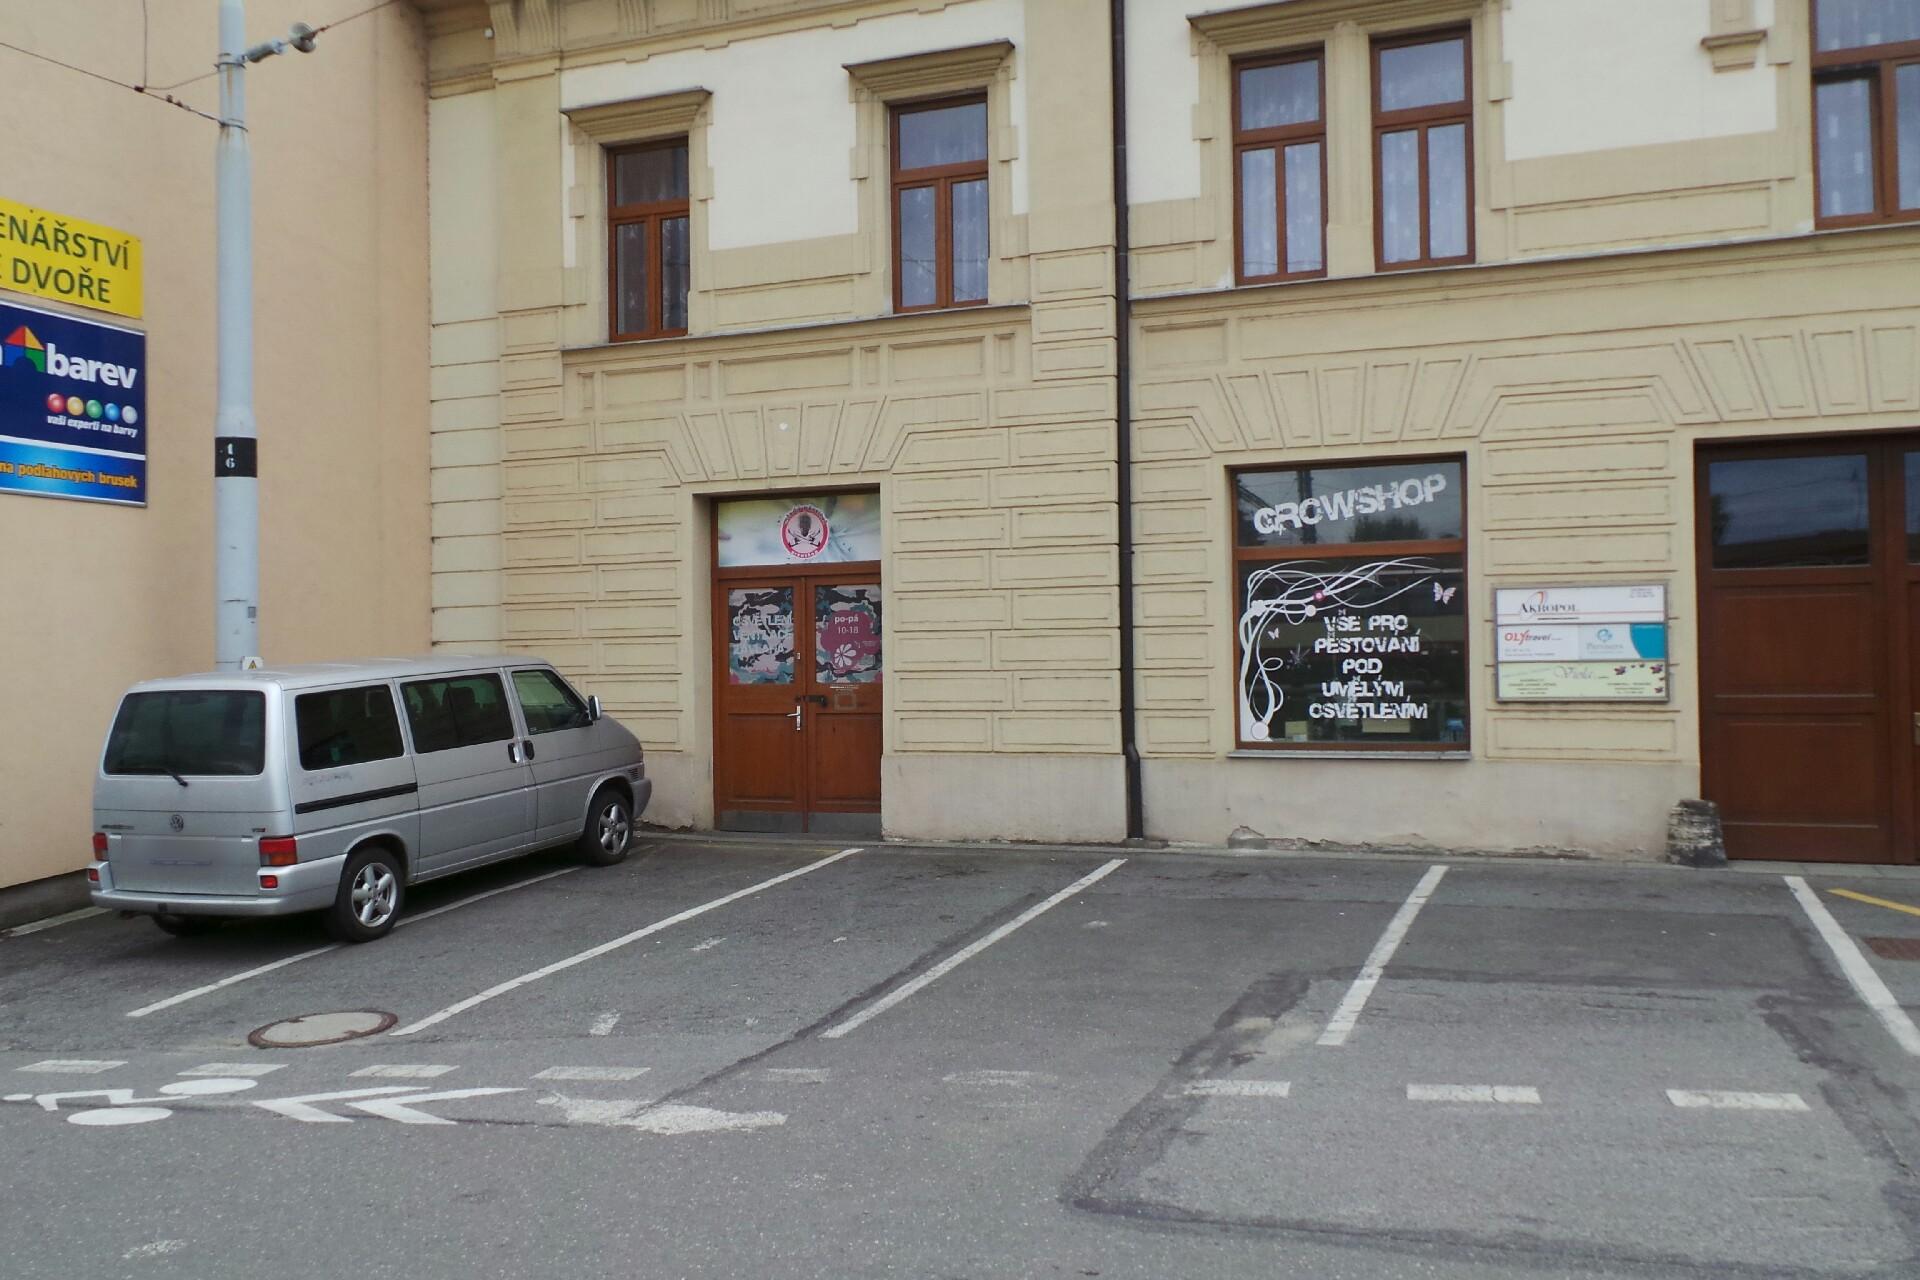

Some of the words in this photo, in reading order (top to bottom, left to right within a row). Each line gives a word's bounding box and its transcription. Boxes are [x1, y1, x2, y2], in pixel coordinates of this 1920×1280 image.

[13, 257, 110, 302] DVOŘE
[46, 342, 137, 388] barev
[47, 415, 67, 426] vaši
[67, 418, 101, 431] experti
[101, 423, 112, 433] na
[113, 424, 138, 438] barvy
[18, 462, 96, 483] podlahových
[99, 472, 138, 488] brusek
[1254, 473, 1447, 536] GROWSHOP
[834, 613, 859, 624] po-pá
[838, 626, 859, 634] 10-18
[1323, 609, 1361, 632] VŠE
[1368, 615, 1409, 631] PRO
[1314, 628, 1421, 653] PĚSTOVÁNÍ
[1342, 658, 1383, 674] POD
[1321, 675, 1404, 697] UMĚLÝM
[1308, 695, 1428, 719] OSVĚTLENÍM
